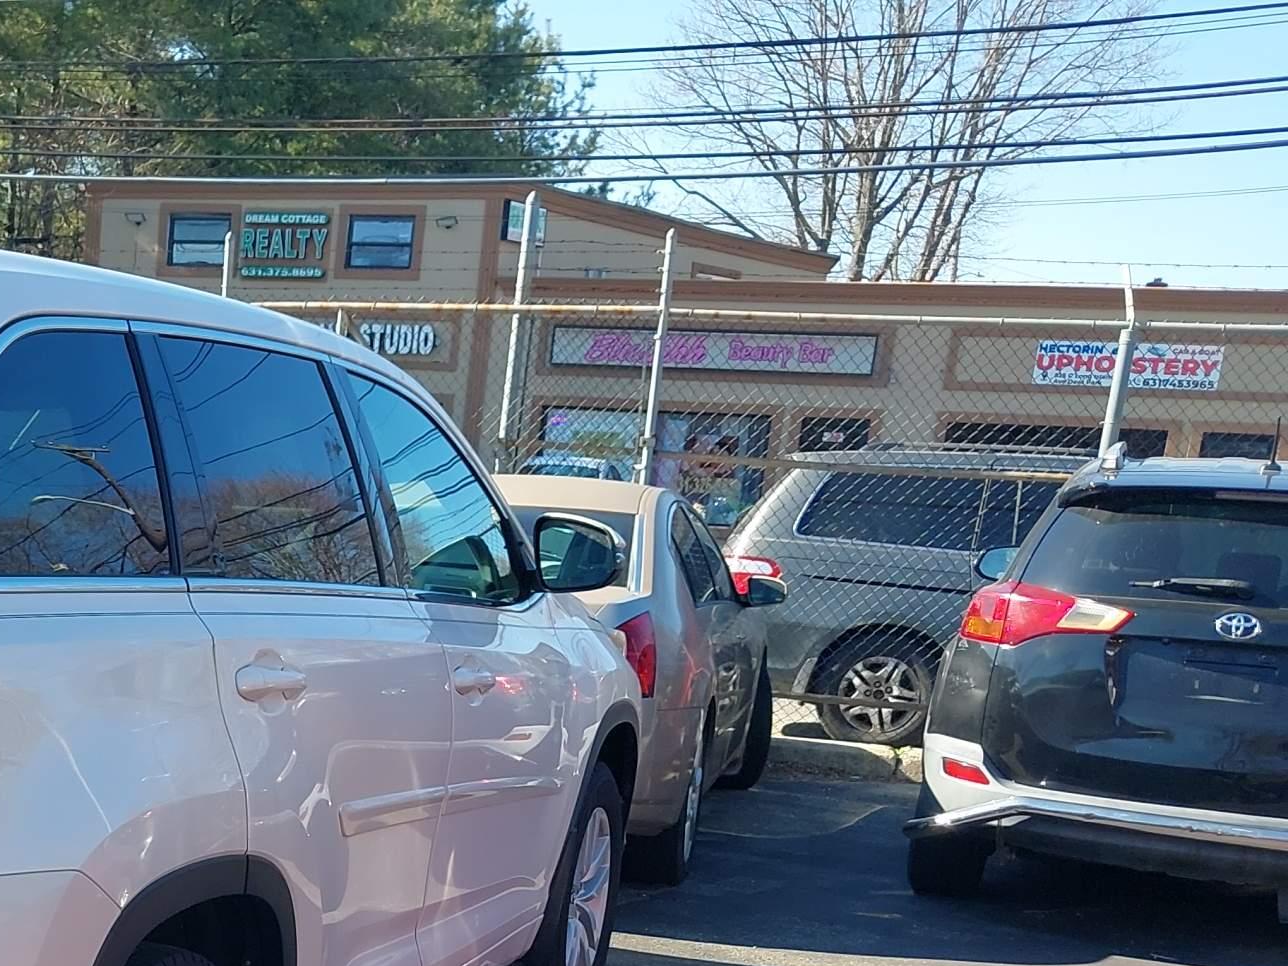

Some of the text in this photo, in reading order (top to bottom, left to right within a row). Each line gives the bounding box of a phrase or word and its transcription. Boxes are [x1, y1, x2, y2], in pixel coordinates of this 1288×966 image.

[245, 213, 327, 224] DREAM COTTAGE
[241, 227, 328, 259] REALTY
[359, 323, 435, 355] STUDIO
[728, 337, 792, 368] Beauty
[798, 341, 835, 364] Bar
[1039, 343, 1104, 354] HECTORIN
[1037, 354, 1221, 377] UPHOSTERY
